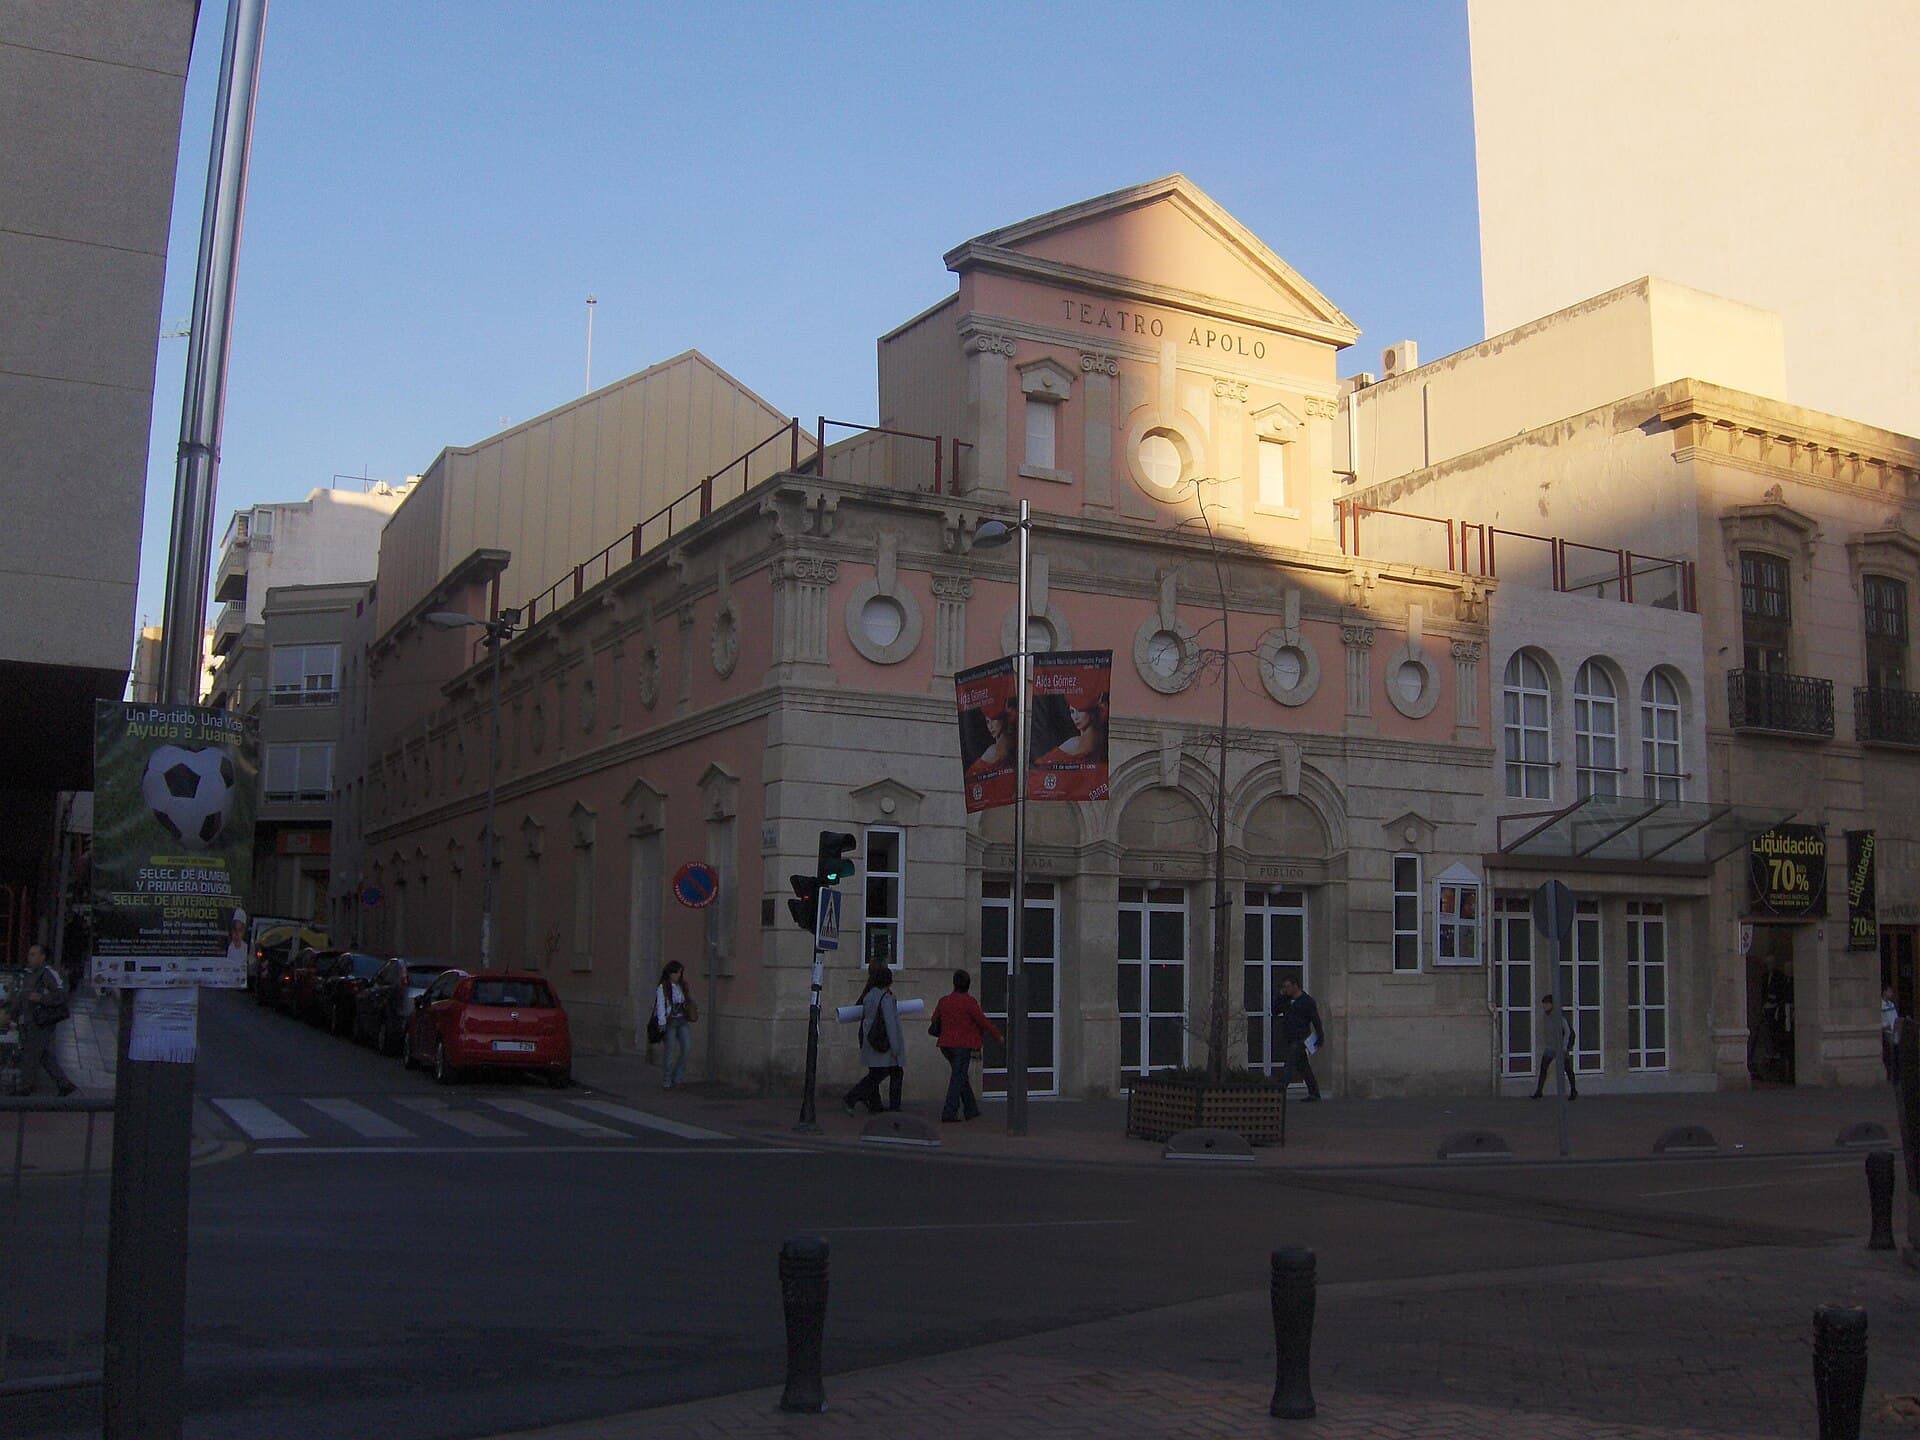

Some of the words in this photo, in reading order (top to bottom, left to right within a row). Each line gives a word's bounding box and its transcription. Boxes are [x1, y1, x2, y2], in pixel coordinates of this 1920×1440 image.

[1063, 300, 1164, 337] TEATRO
[1188, 328, 1266, 359] APOLO
[126, 708, 145, 721] Un
[149, 708, 198, 726] Partido,
[201, 712, 223, 727] Una
[126, 722, 178, 740] Ayuda
[184, 727, 193, 739] a
[197, 725, 242, 745] Juanma
[1088, 783, 1109, 801] danza
[1752, 835, 1826, 856] Liquidación
[1000, 856, 1054, 869] ENADA
[139, 868, 178, 880] SELEC.
[181, 869, 194, 880] DE
[147, 881, 198, 892] PRIMERA
[113, 895, 151, 906] SELEC.
[154, 895, 169, 906] DE
